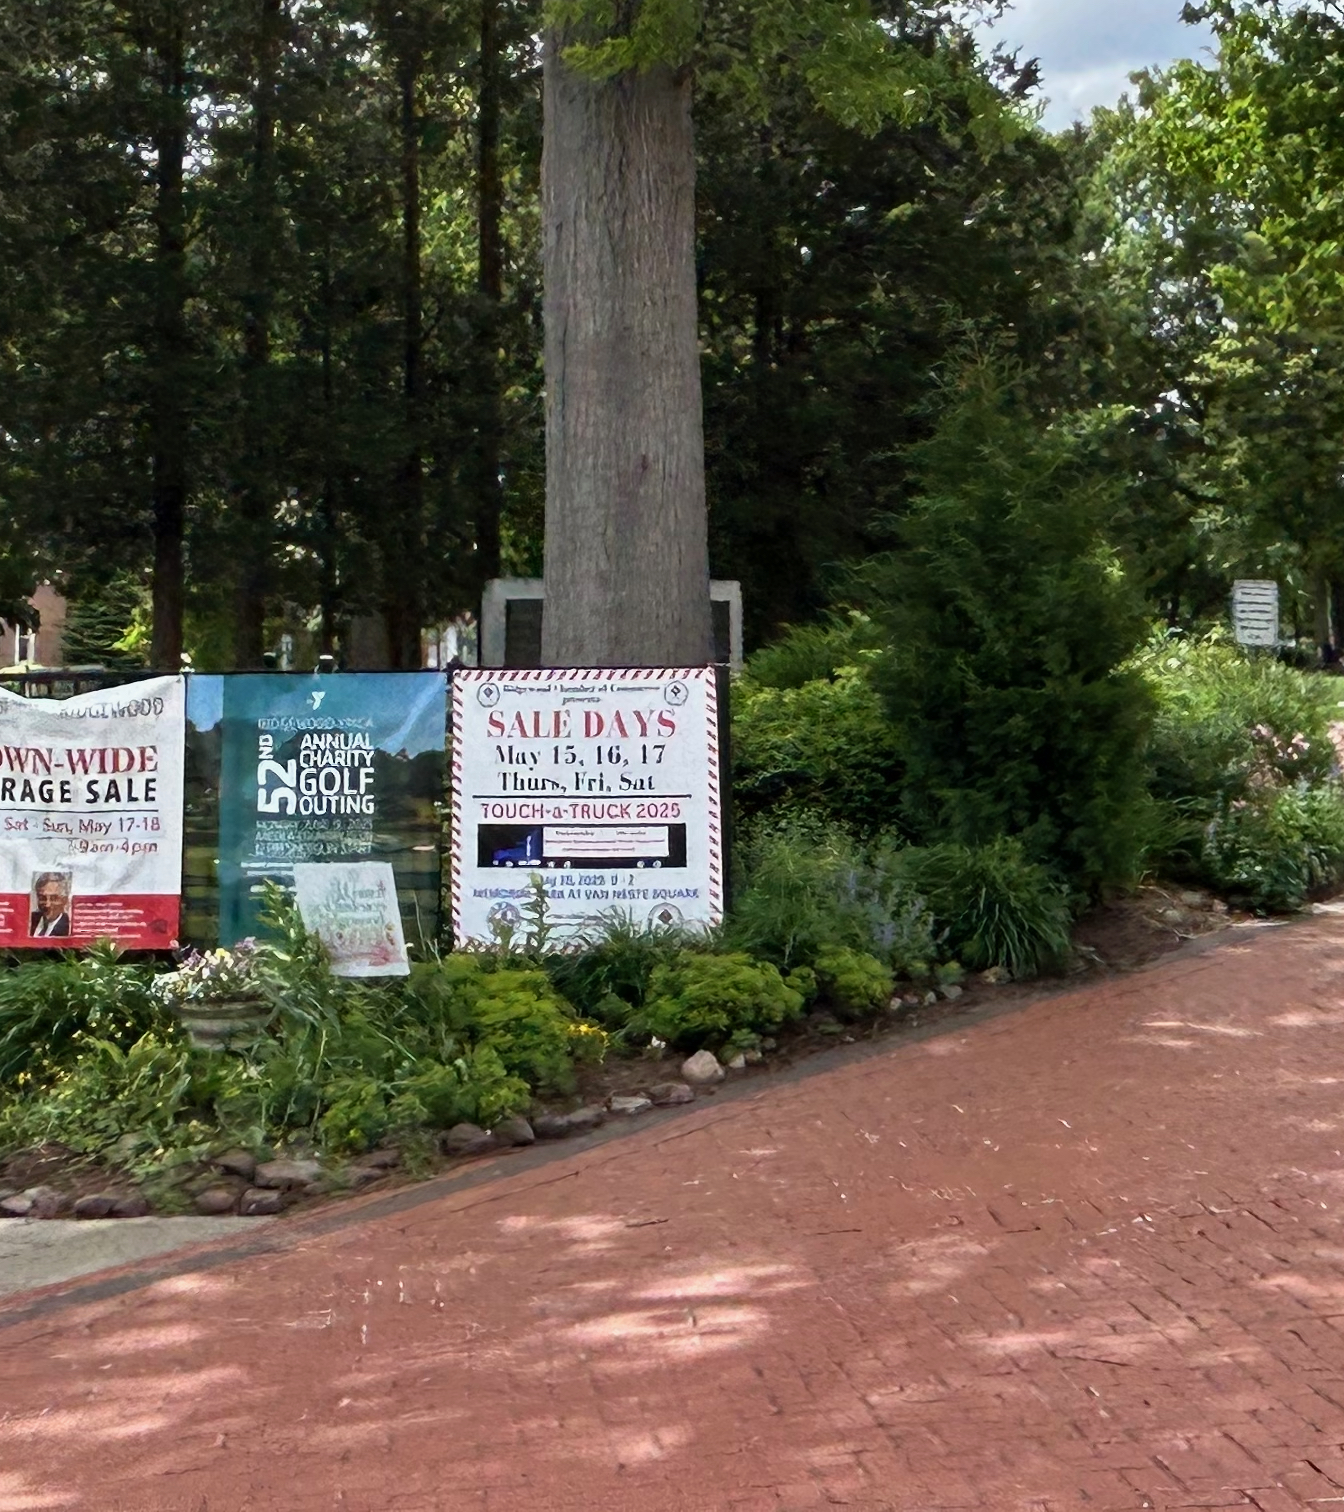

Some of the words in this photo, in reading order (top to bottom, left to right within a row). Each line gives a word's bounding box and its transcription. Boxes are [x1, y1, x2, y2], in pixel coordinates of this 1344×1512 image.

[487, 709, 572, 738] SALE
[583, 709, 677, 738] DAYS
[300, 731, 374, 750] ANNUAL
[299, 749, 375, 769] CHARITY
[496, 744, 541, 770] May
[553, 744, 585, 767] 15,
[596, 744, 629, 767] 16,
[640, 744, 666, 764] 17
[85, 777, 157, 803] SALE
[299, 766, 375, 797] GOLF
[574, 771, 612, 792] Fri,
[619, 772, 656, 791] Sat
[299, 794, 375, 815] OUTING
[636, 802, 681, 820] 2025
[4, 816, 29, 832] Sat
[79, 818, 112, 836] May
[119, 816, 161, 833] 17-18
